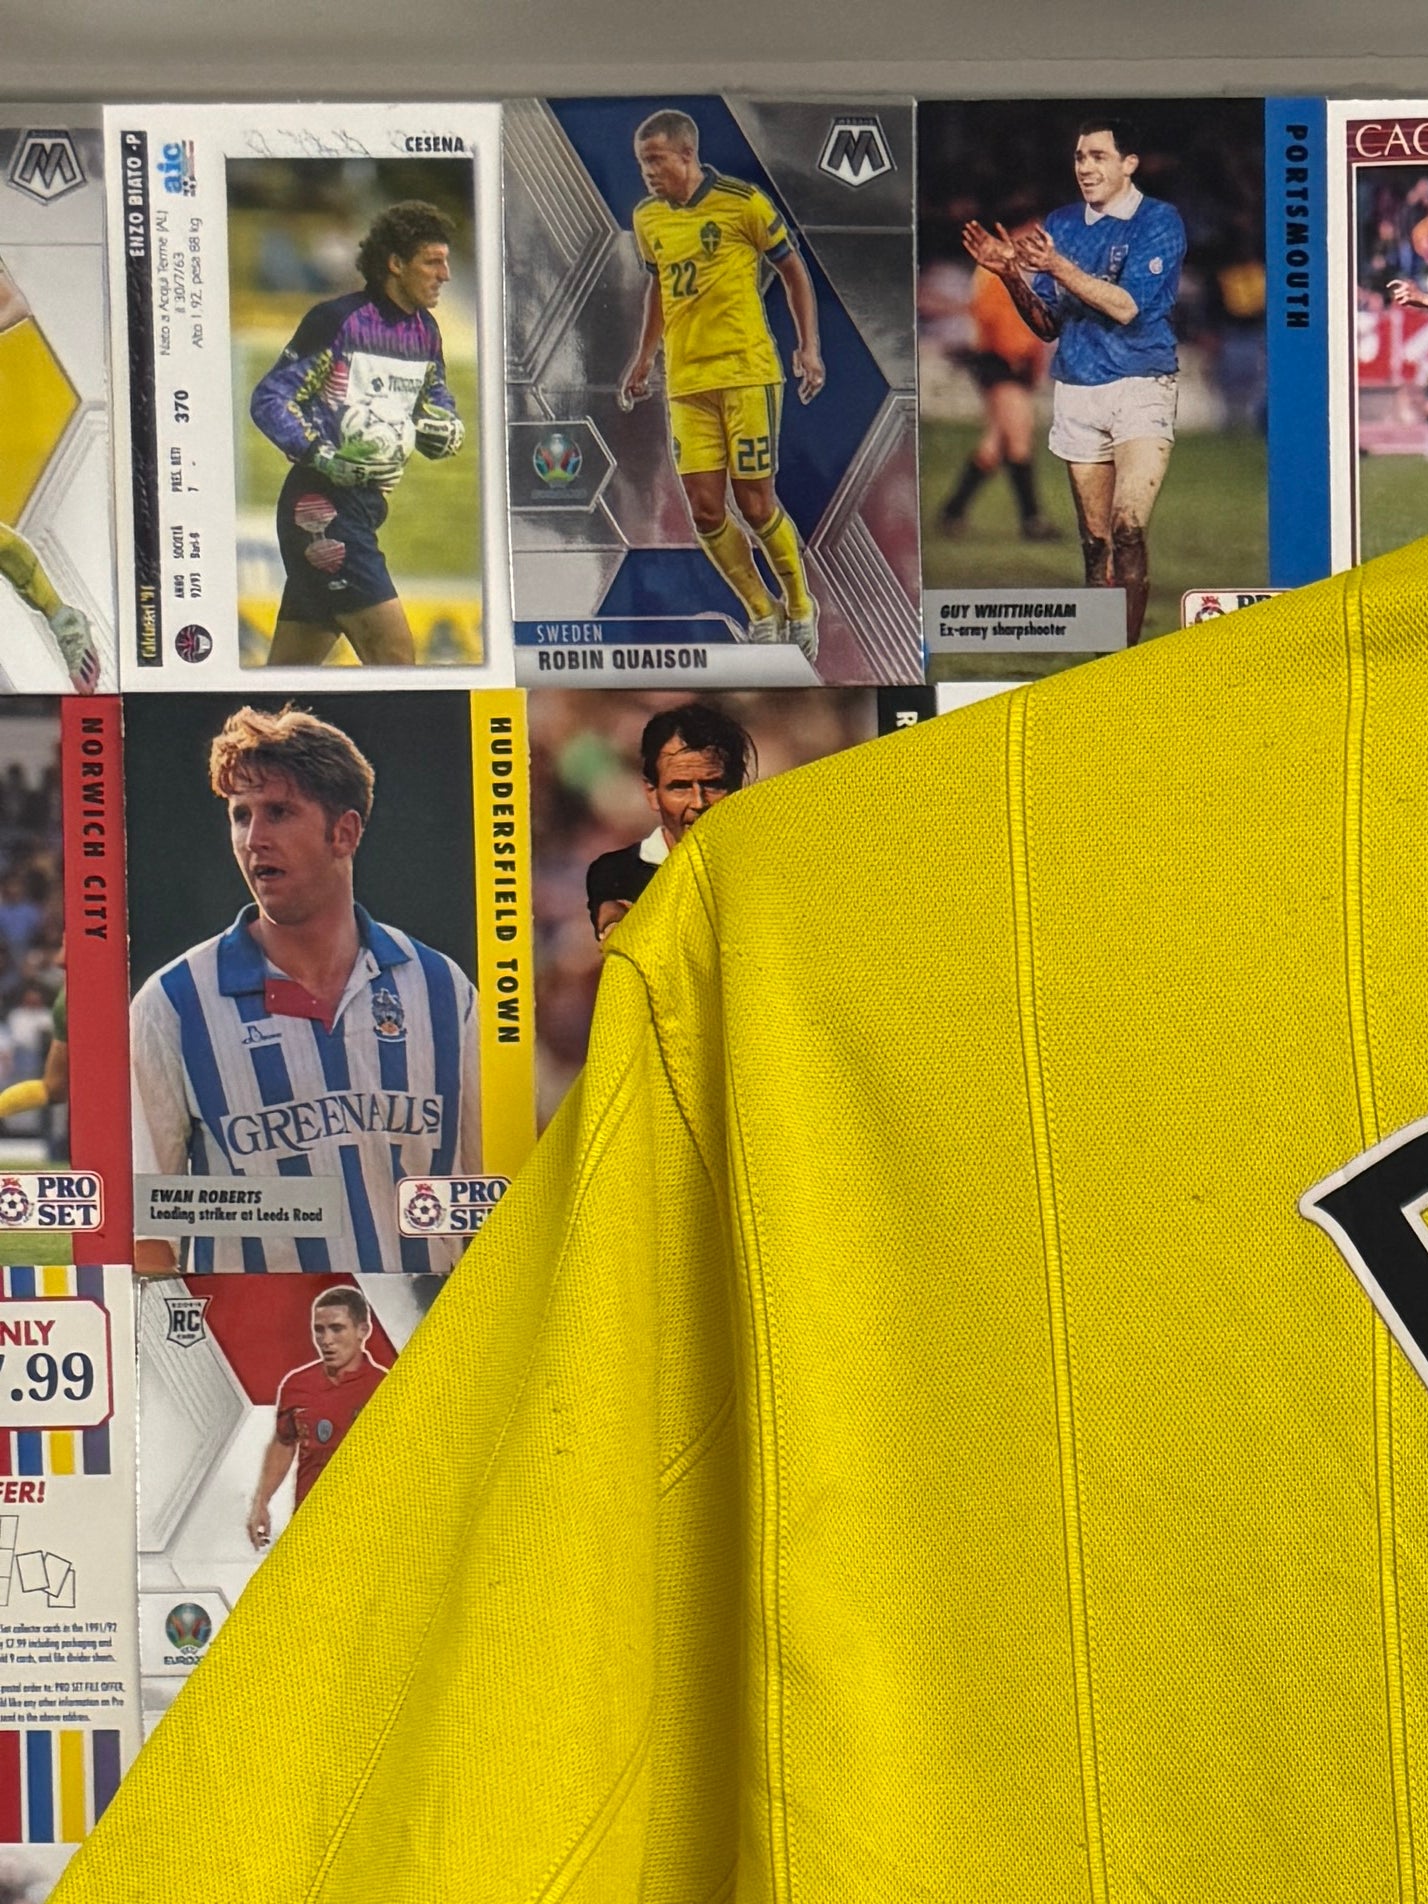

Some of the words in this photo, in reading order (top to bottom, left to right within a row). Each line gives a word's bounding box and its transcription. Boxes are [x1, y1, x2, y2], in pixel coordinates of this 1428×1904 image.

[404, 135, 465, 154] CESENA
[126, 158, 144, 205] BIATO
[128, 213, 146, 257] ENZO
[1283, 124, 1310, 330] PORTSMOUTH
[668, 262, 699, 299] 22
[174, 388, 190, 423] 370
[737, 437, 771, 472] 22
[939, 603, 969, 619] GUY
[973, 602, 1077, 619] WHITTINGHAM
[535, 623, 603, 644] SWEDEN
[991, 620, 1067, 640] sharpshooter
[538, 649, 603, 670] ROBIN
[611, 648, 708, 670] QUAISON
[81, 717, 105, 858] NORWICH
[490, 717, 519, 942] HUDDERSFIELD
[83, 875, 108, 940] CITY
[495, 959, 521, 1043] TOWN
[227, 1096, 441, 1157] GREENALLS
[37, 1177, 97, 1198] PRO
[150, 1189, 194, 1204] EWAN
[199, 1189, 263, 1204] ROBERTS
[449, 1180, 506, 1201] PRO
[37, 1204, 98, 1227] SET
[149, 1206, 195, 1224] Leading
[198, 1206, 237, 1222] striker
[240, 1208, 253, 1222] at
[256, 1206, 290, 1222] Leeds
[292, 1206, 323, 1222] Road
[449, 1208, 492, 1229] SE
